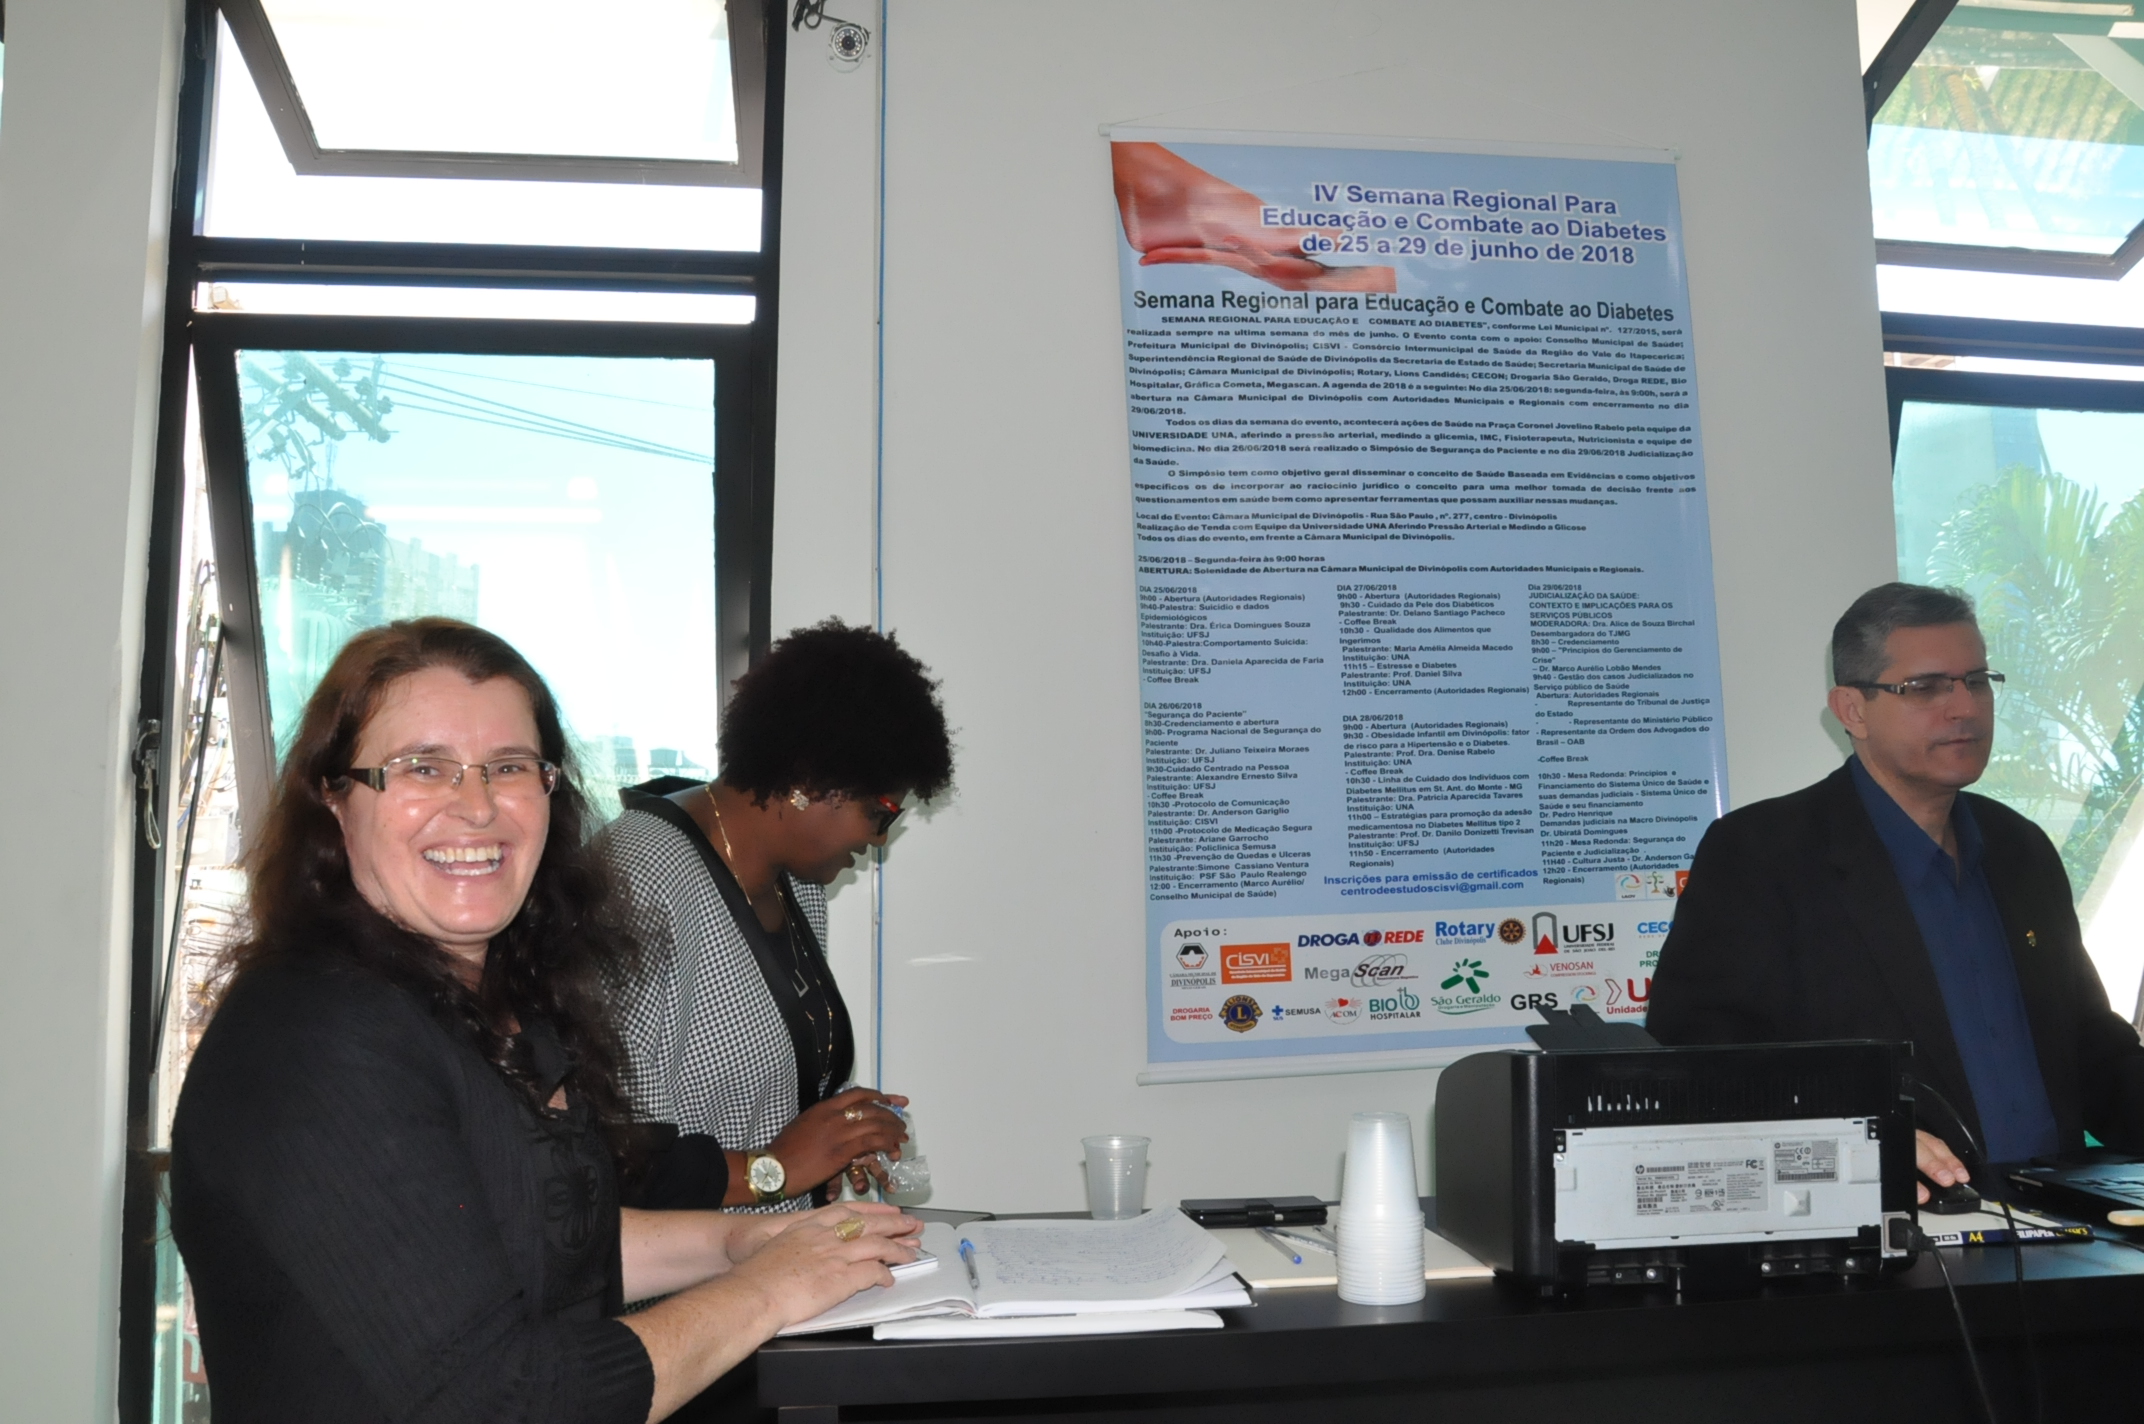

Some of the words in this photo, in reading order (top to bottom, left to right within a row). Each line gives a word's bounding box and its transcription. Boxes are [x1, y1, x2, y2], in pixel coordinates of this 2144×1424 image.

[1314, 184, 1339, 202] IV
[1347, 185, 1445, 206] Semana
[1453, 189, 1557, 212] Regional
[1565, 195, 1617, 214] Para
[1263, 208, 1387, 231] Educação
[1395, 216, 1408, 229] e
[1417, 213, 1523, 234] Combate
[1531, 222, 1559, 236] ao
[1567, 220, 1666, 241] Diabetes
[1302, 234, 1332, 252] de
[1340, 236, 1369, 253] 25
[1377, 240, 1391, 254] a
[1398, 237, 1426, 254] 29
[1434, 239, 1463, 256] de
[1471, 240, 1538, 260] junho
[1546, 244, 1574, 260] de
[1582, 245, 1634, 264] 2018
[1133, 290, 1215, 308] Semana
[1221, 291, 1308, 313] Regional
[1316, 298, 1358, 313] para
[1365, 293, 1459, 316] Educação
[1465, 301, 1475, 313] e
[1481, 297, 1563, 317] Combate
[1570, 304, 1591, 317] ao
[1597, 301, 1674, 321] Diabetes
[1207, 315, 1262, 324] REGIONAL
[1263, 316, 1291, 324] PARA
[1293, 316, 1350, 325] EDUCAÇÃO
[1368, 317, 1416, 327] COMBATE
[1491, 323, 1536, 331] conforme
[1554, 324, 1598, 333] Municipal
[1131, 429, 1208, 439] UNIVERSIDADE
[1240, 431, 1282, 439] aferindo
[1294, 431, 1335, 440] pressão
[1380, 432, 1422, 440] medindo
[1577, 435, 1636, 444] Nutricionista
[1646, 438, 1677, 446] equipe
[1193, 566, 1248, 574] Solenidade
[1262, 565, 1306, 573] Abertura
[1358, 564, 1404, 574] Municipal
[1404, 564, 1417, 572] de
[1417, 564, 1468, 574] Divinópolis
[1489, 564, 1544, 572] Autoridades
[1545, 565, 1592, 574] Municipais
[1599, 565, 1644, 575] Regionais.
[1153, 586, 1197, 594] 25/06/2018
[1353, 583, 1397, 591] 27/06/2018
[1528, 591, 1595, 601] JUDICIALIZAÇÃO
[1581, 600, 1636, 610] IMPLICAÇÕES
[1433, 609, 1469, 618] Santiago
[1470, 608, 1506, 616] Pacheco
[1529, 611, 1570, 620] SERVIÇOS
[1571, 610, 1613, 619] PÚBLICOS
[1209, 620, 1232, 629] Érica
[1233, 621, 1282, 630] Domingues
[1284, 620, 1311, 628] Souza
[1641, 619, 1666, 627] Souza
[1530, 630, 1595, 638] Desembargadora
[1596, 629, 1607, 637] do
[1324, 875, 1383, 885] Inscrições
[1385, 875, 1409, 884] para
[1412, 872, 1458, 882] emissão
[1461, 871, 1474, 880] de
[1477, 869, 1538, 879] certificados
[1542, 875, 1585, 886] Regionais)
[1340, 881, 1524, 896] centrodeestudoscisvi@gmail.com
[1149, 892, 1189, 901] Conselho
[1190, 891, 1232, 901] Municipal
[1234, 890, 1245, 898] de
[1246, 889, 1277, 899] Saúde)
[1174, 927, 1227, 939] Apoio:
[1435, 921, 1495, 938] Rotary
[1563, 923, 1614, 943] UFSJ
[1298, 933, 1360, 947] DROGA
[1384, 930, 1424, 944] REDE
[1304, 967, 1350, 981] Mega
[1354, 964, 1405, 978] Scan
[1550, 962, 1594, 971] VENOSAN
[1171, 977, 1216, 986] DIVINÓPOLIS
[1369, 998, 1398, 1012] BIO
[1431, 996, 1453, 1006] São
[1455, 993, 1501, 1005] Geraldo
[1511, 993, 1558, 1010] GRS
[1188, 1013, 1213, 1021] PREÇO
[1285, 1008, 1321, 1016] SEMUSA
[1370, 1011, 1421, 1020] HOSPITALAR
[1969, 1230, 1984, 1242] A4
